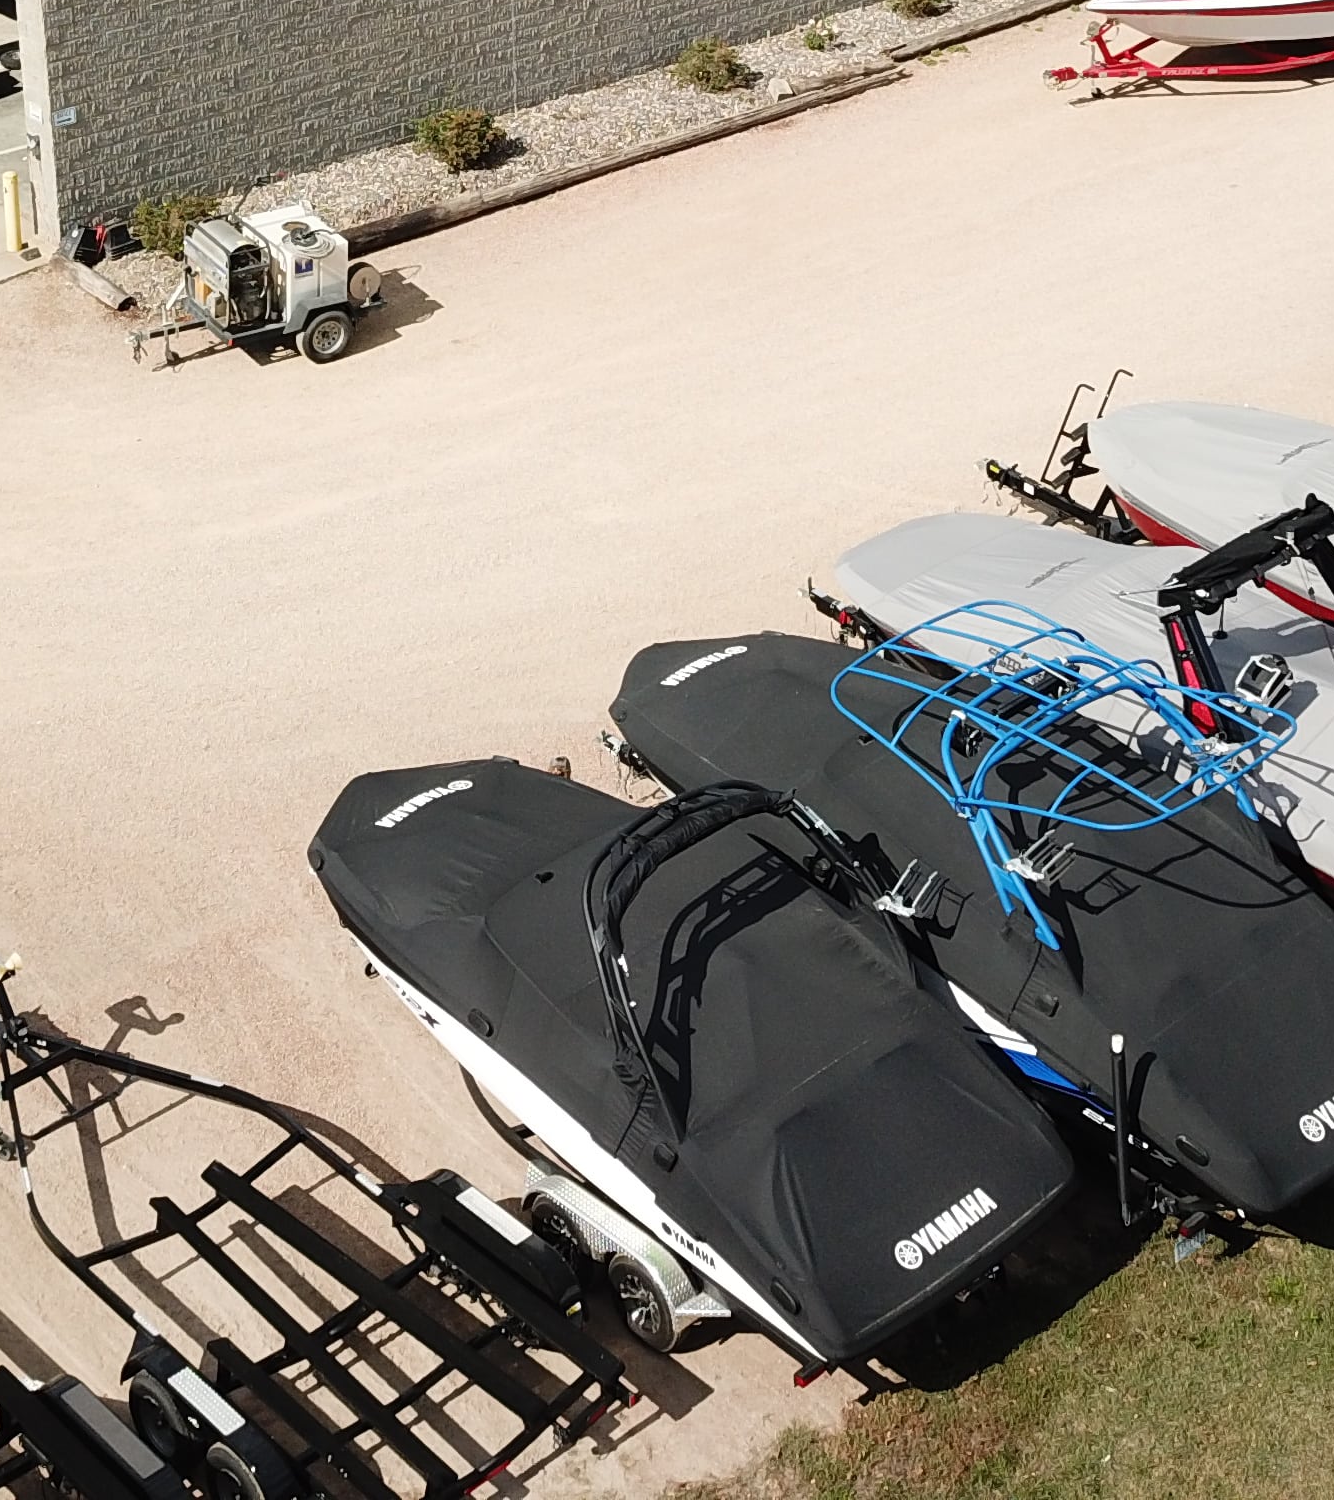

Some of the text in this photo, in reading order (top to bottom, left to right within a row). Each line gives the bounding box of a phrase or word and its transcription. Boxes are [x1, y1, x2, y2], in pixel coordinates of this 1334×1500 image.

[660, 651, 733, 687] YAMAHA
[374, 786, 457, 829] YAMAHA
[911, 1187, 998, 1256] YAMAHA
[672, 1229, 717, 1271] YAMAHA
